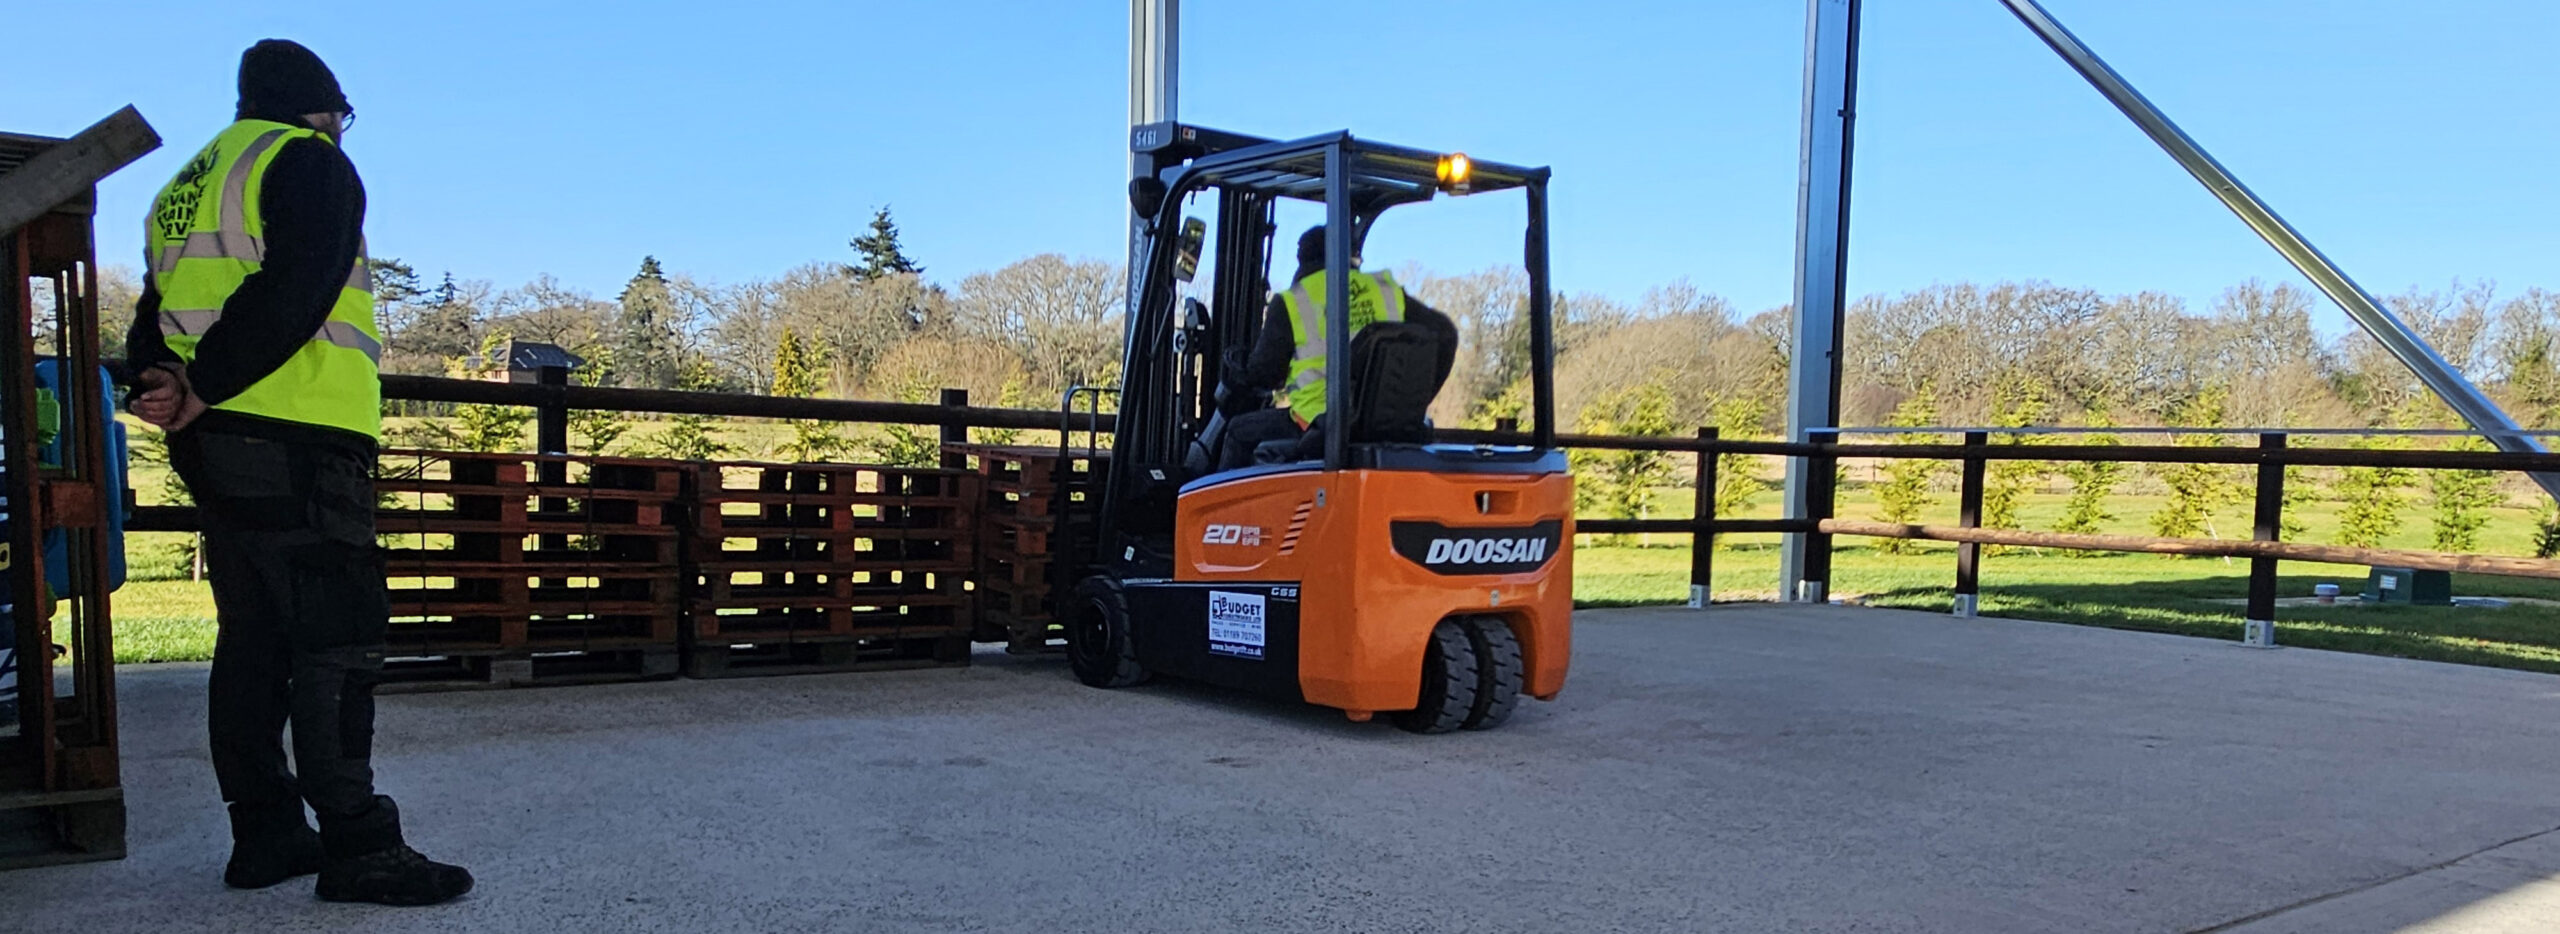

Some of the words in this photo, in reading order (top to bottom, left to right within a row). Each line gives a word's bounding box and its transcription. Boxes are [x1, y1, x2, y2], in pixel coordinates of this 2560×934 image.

[1136, 129, 1157, 147] 5461
[1202, 524, 1242, 544] 20
[1425, 537, 1547, 564] DOOSAN
[1221, 597, 1261, 616] BUDGET
